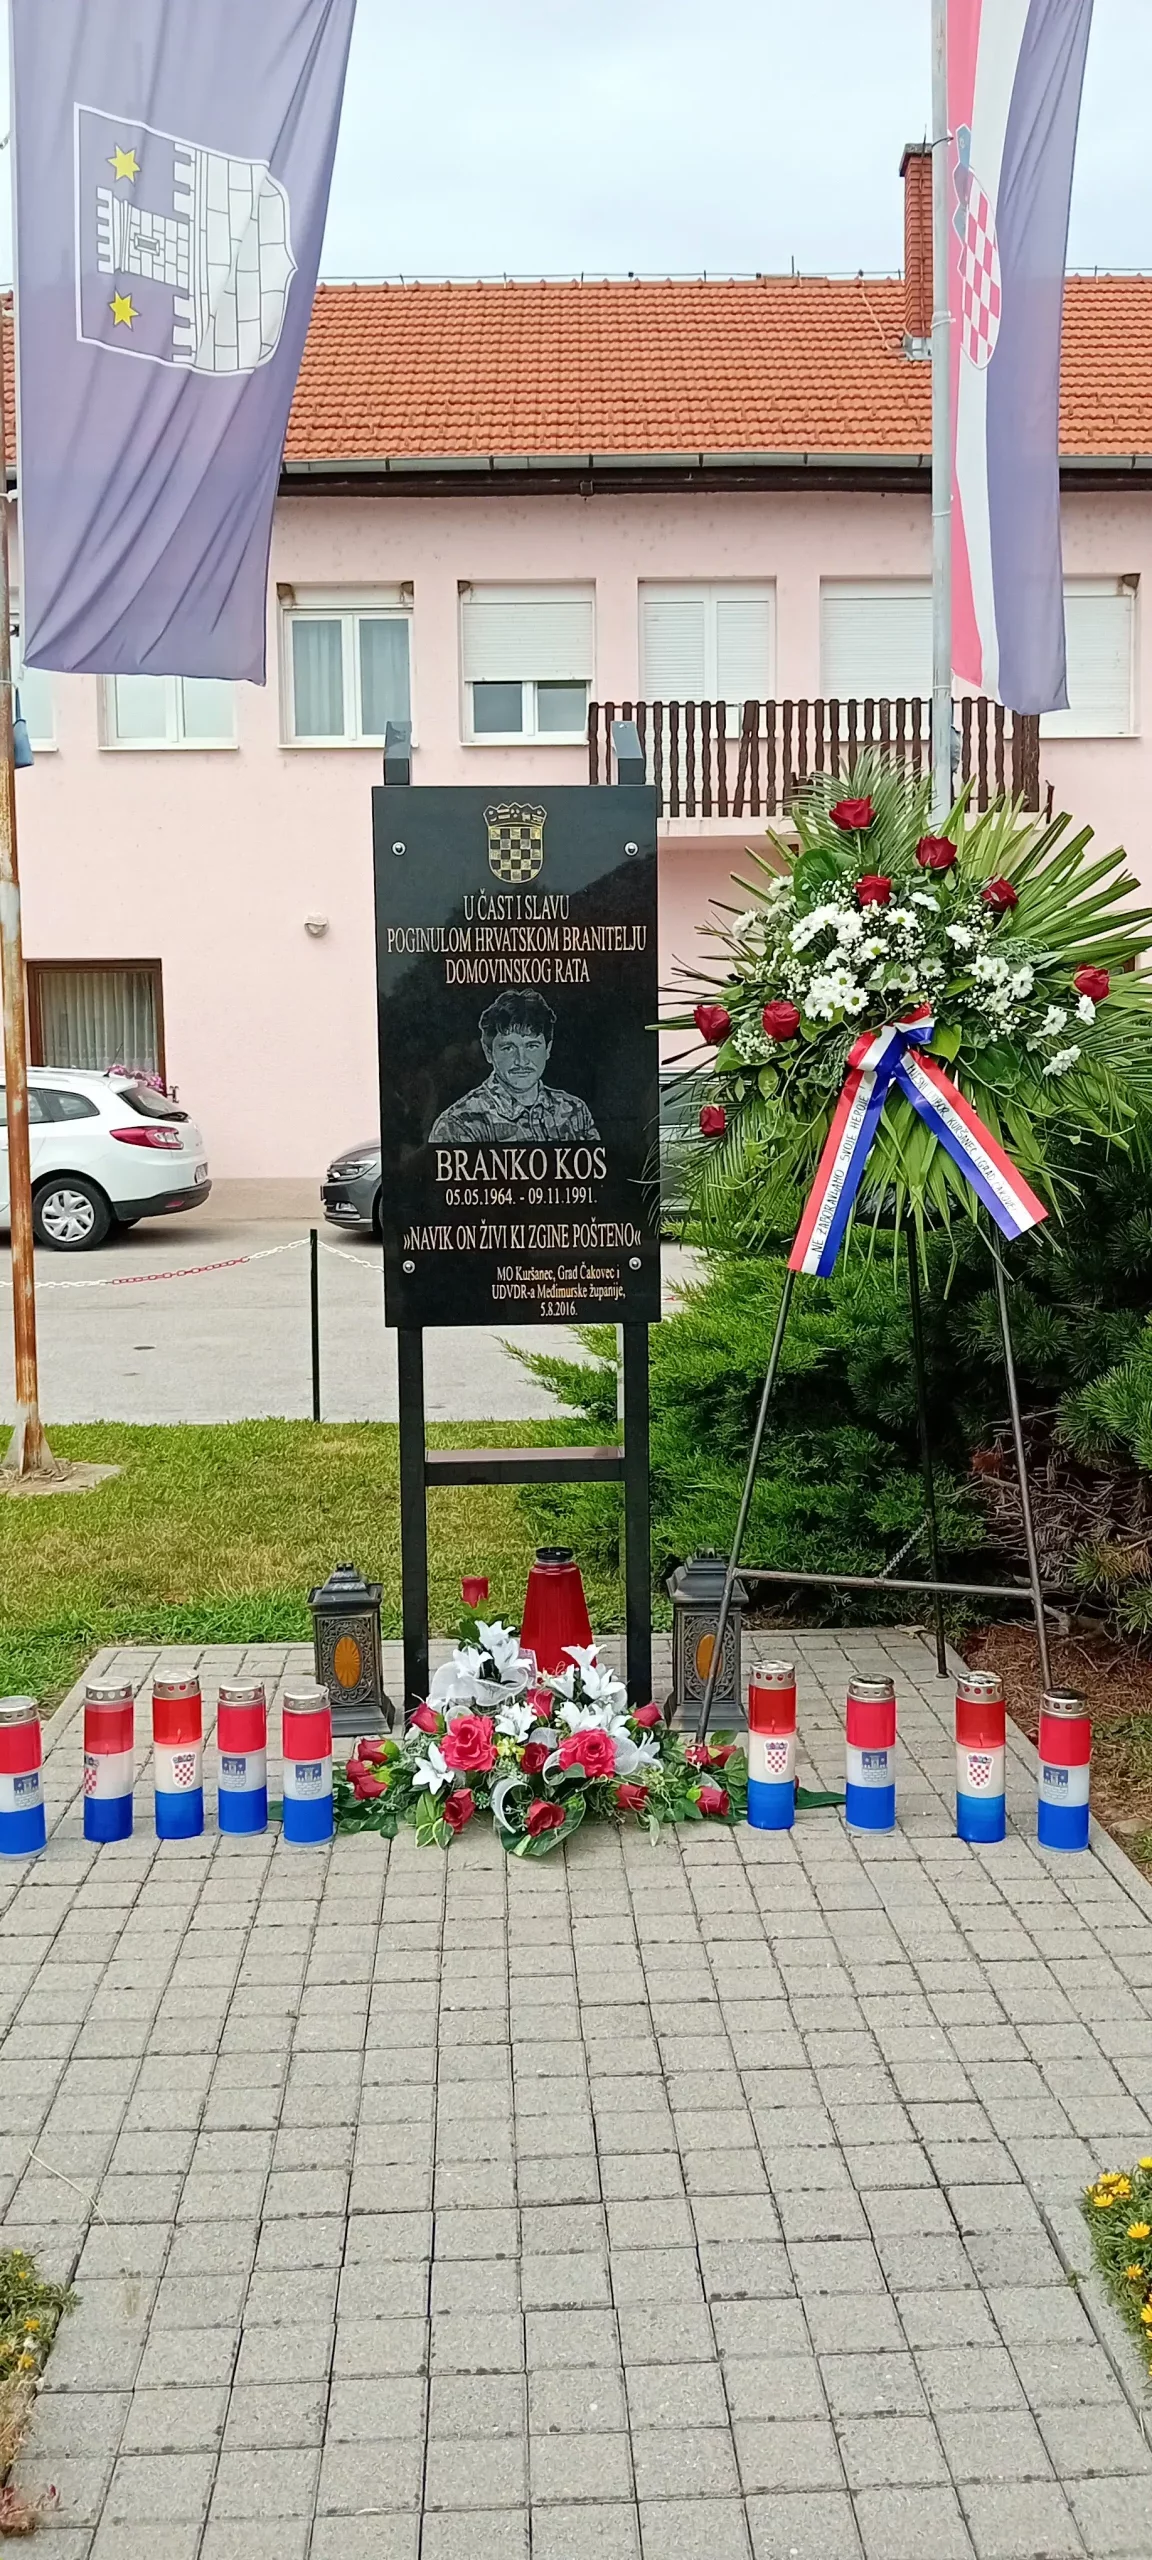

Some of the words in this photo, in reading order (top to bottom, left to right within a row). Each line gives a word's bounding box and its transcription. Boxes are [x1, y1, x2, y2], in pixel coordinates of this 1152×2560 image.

[463, 895, 474, 921] U
[477, 888, 514, 921] ČAST
[517, 895, 522, 920] I
[525, 894, 570, 920] SLAVU
[387, 927, 471, 953] POGINULOM
[475, 926, 559, 953] HRVATSKOM
[563, 925, 648, 952] BRANITELJU
[445, 958, 552, 984] DOMOVINSKOG
[555, 958, 591, 983] RATA
[839, 1133, 857, 1163] SVOJE
[946, 1117, 978, 1155] KURŠANEC
[977, 1159, 996, 1185] GRAD
[435, 1148, 548, 1181] BRANKO
[554, 1147, 607, 1180] KOS
[445, 1187, 516, 1206] 05.05.1964.
[528, 1186, 597, 1205] 09.11.1991.
[456, 1225, 476, 1250] ON
[480, 1218, 507, 1250] ŽIVI
[510, 1225, 525, 1249] KI
[528, 1224, 570, 1249] ZGINE
[497, 1265, 514, 1281] MO
[515, 1265, 556, 1282] Kuršanec,
[557, 1265, 578, 1280] Grad
[580, 1261, 615, 1280] Čakovec
[491, 1284, 536, 1300] UDVDR-a
[537, 1283, 588, 1299] Međimurske
[589, 1282, 626, 1301] županije,
[540, 1301, 578, 1316] 5.8.2016.
